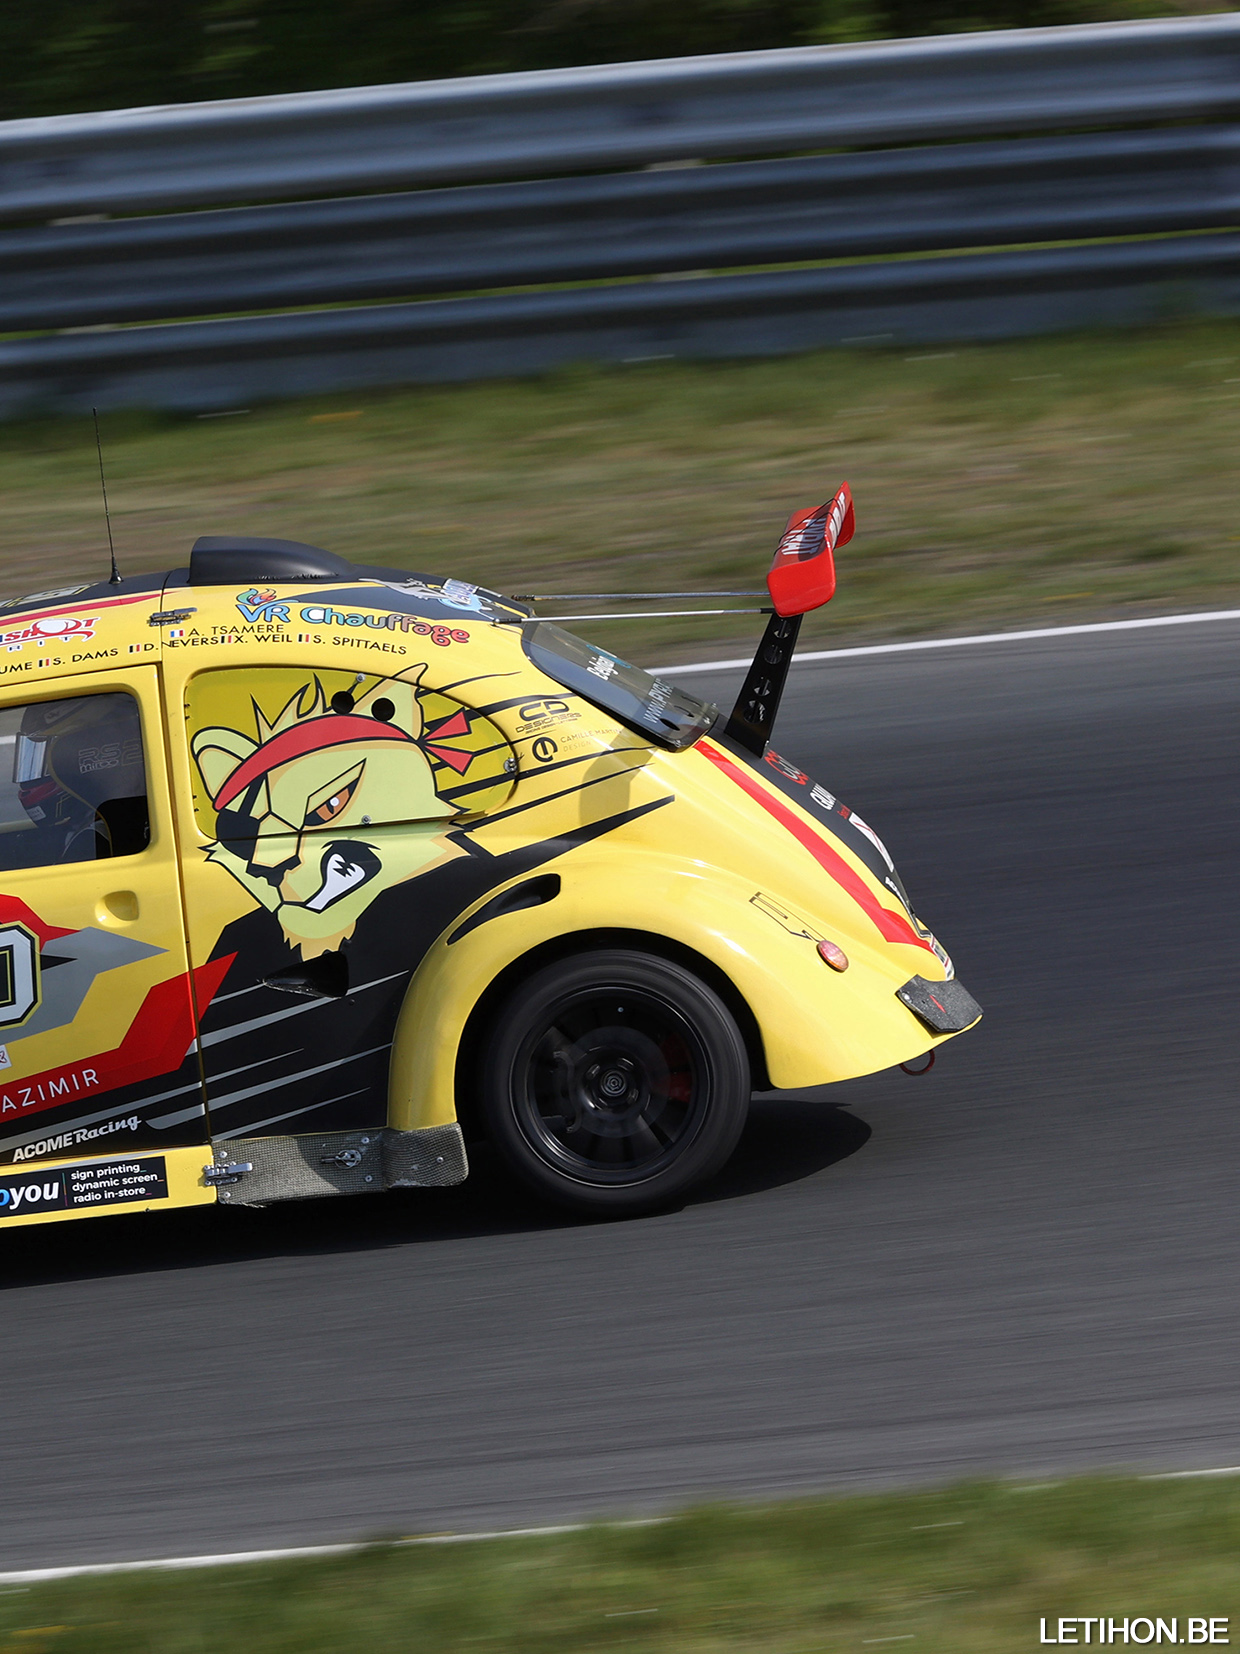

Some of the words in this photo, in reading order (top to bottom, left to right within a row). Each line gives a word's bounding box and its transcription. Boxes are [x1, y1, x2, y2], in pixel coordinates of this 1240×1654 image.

[188, 627, 205, 637] A.
[211, 625, 285, 635] TSAMERE
[236, 601, 291, 624] VR
[300, 606, 470, 647] Chauffage
[52, 657, 66, 666] S.
[72, 648, 119, 663] DAMS
[143, 642, 159, 652] D.
[233, 635, 248, 644] X.
[254, 634, 293, 644] WEIL
[313, 635, 326, 644] S.
[332, 636, 407, 655] SPITTAELS
[560, 731, 594, 743] CAMILLE
[12, 1132, 73, 1162] ACOME
[73, 1116, 142, 1143] Racing
[71, 1171, 94, 1181] sign
[97, 1164, 140, 1178] printing
[72, 1177, 120, 1193] dynamic
[122, 1173, 158, 1185] screen
[73, 1192, 102, 1203] radio
[104, 1187, 146, 1199] in-store
